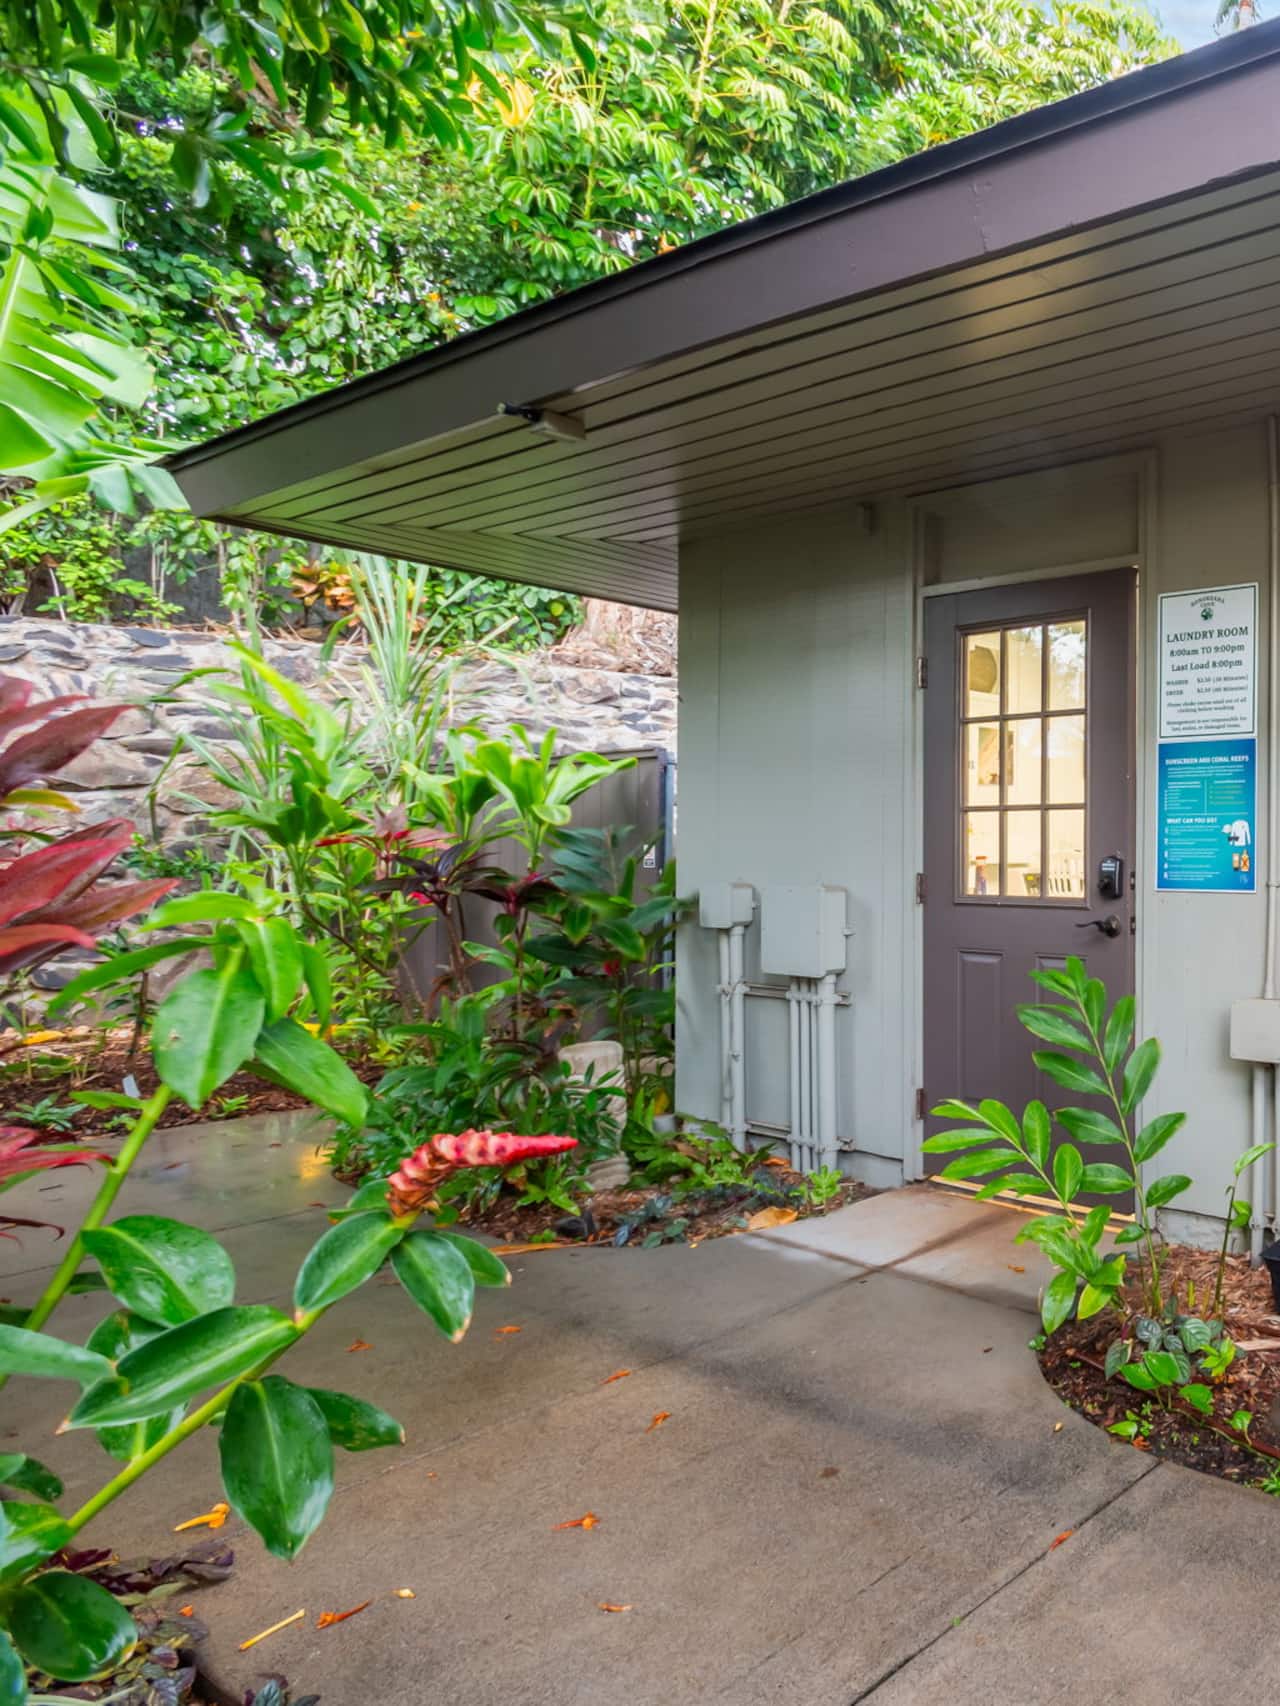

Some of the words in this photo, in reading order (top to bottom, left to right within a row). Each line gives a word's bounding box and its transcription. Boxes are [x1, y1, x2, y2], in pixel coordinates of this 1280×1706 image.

[1167, 629, 1215, 643] LAUNDRY
[1217, 626, 1249, 638] ROOM
[1169, 648, 1199, 657] 8:00am
[1202, 646, 1212, 654] TO
[1214, 644, 1245, 653] 9:00pm
[1171, 663, 1188, 672] Last
[1190, 661, 1210, 670] Load
[1212, 659, 1243, 669] 8:00pm
